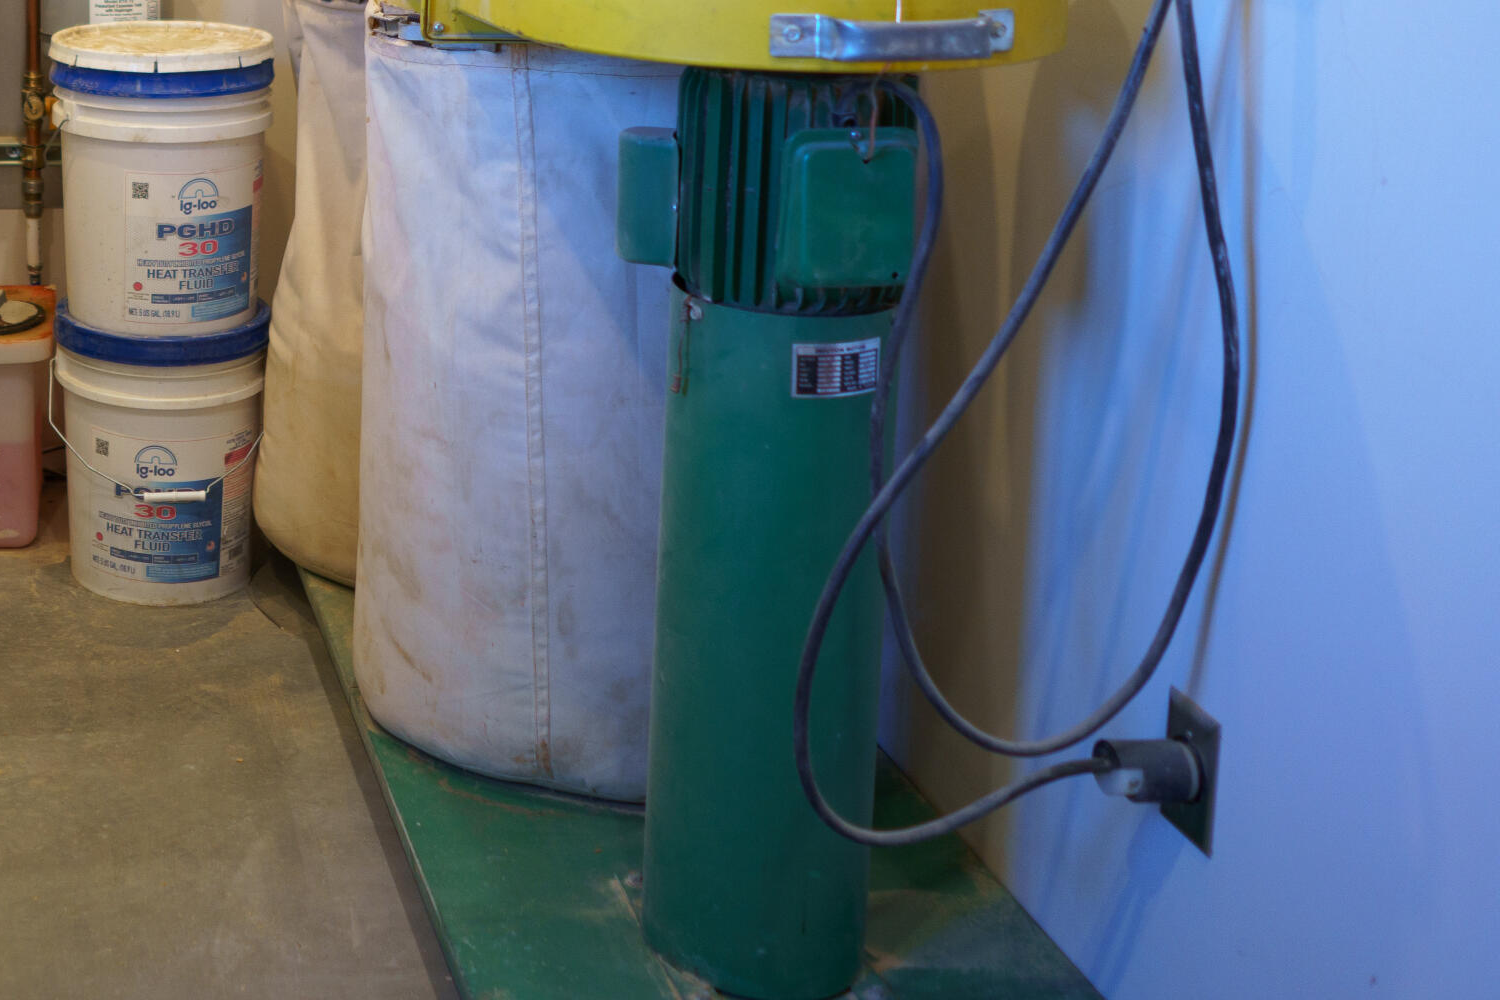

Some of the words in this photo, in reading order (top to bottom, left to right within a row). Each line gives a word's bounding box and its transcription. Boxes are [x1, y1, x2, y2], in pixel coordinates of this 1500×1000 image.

[179, 199, 217, 215] ig-loo
[156, 218, 235, 240] PGHD
[178, 240, 219, 256] 30
[147, 268, 178, 279] HEAT
[181, 260, 240, 279] TRANSFER
[179, 279, 213, 290] FLUID
[136, 463, 175, 478] ig-loo
[134, 504, 176, 520] 30
[106, 521, 133, 537] HEAT
[137, 529, 203, 541] TRANSFER
[134, 540, 170, 552] FLUID
